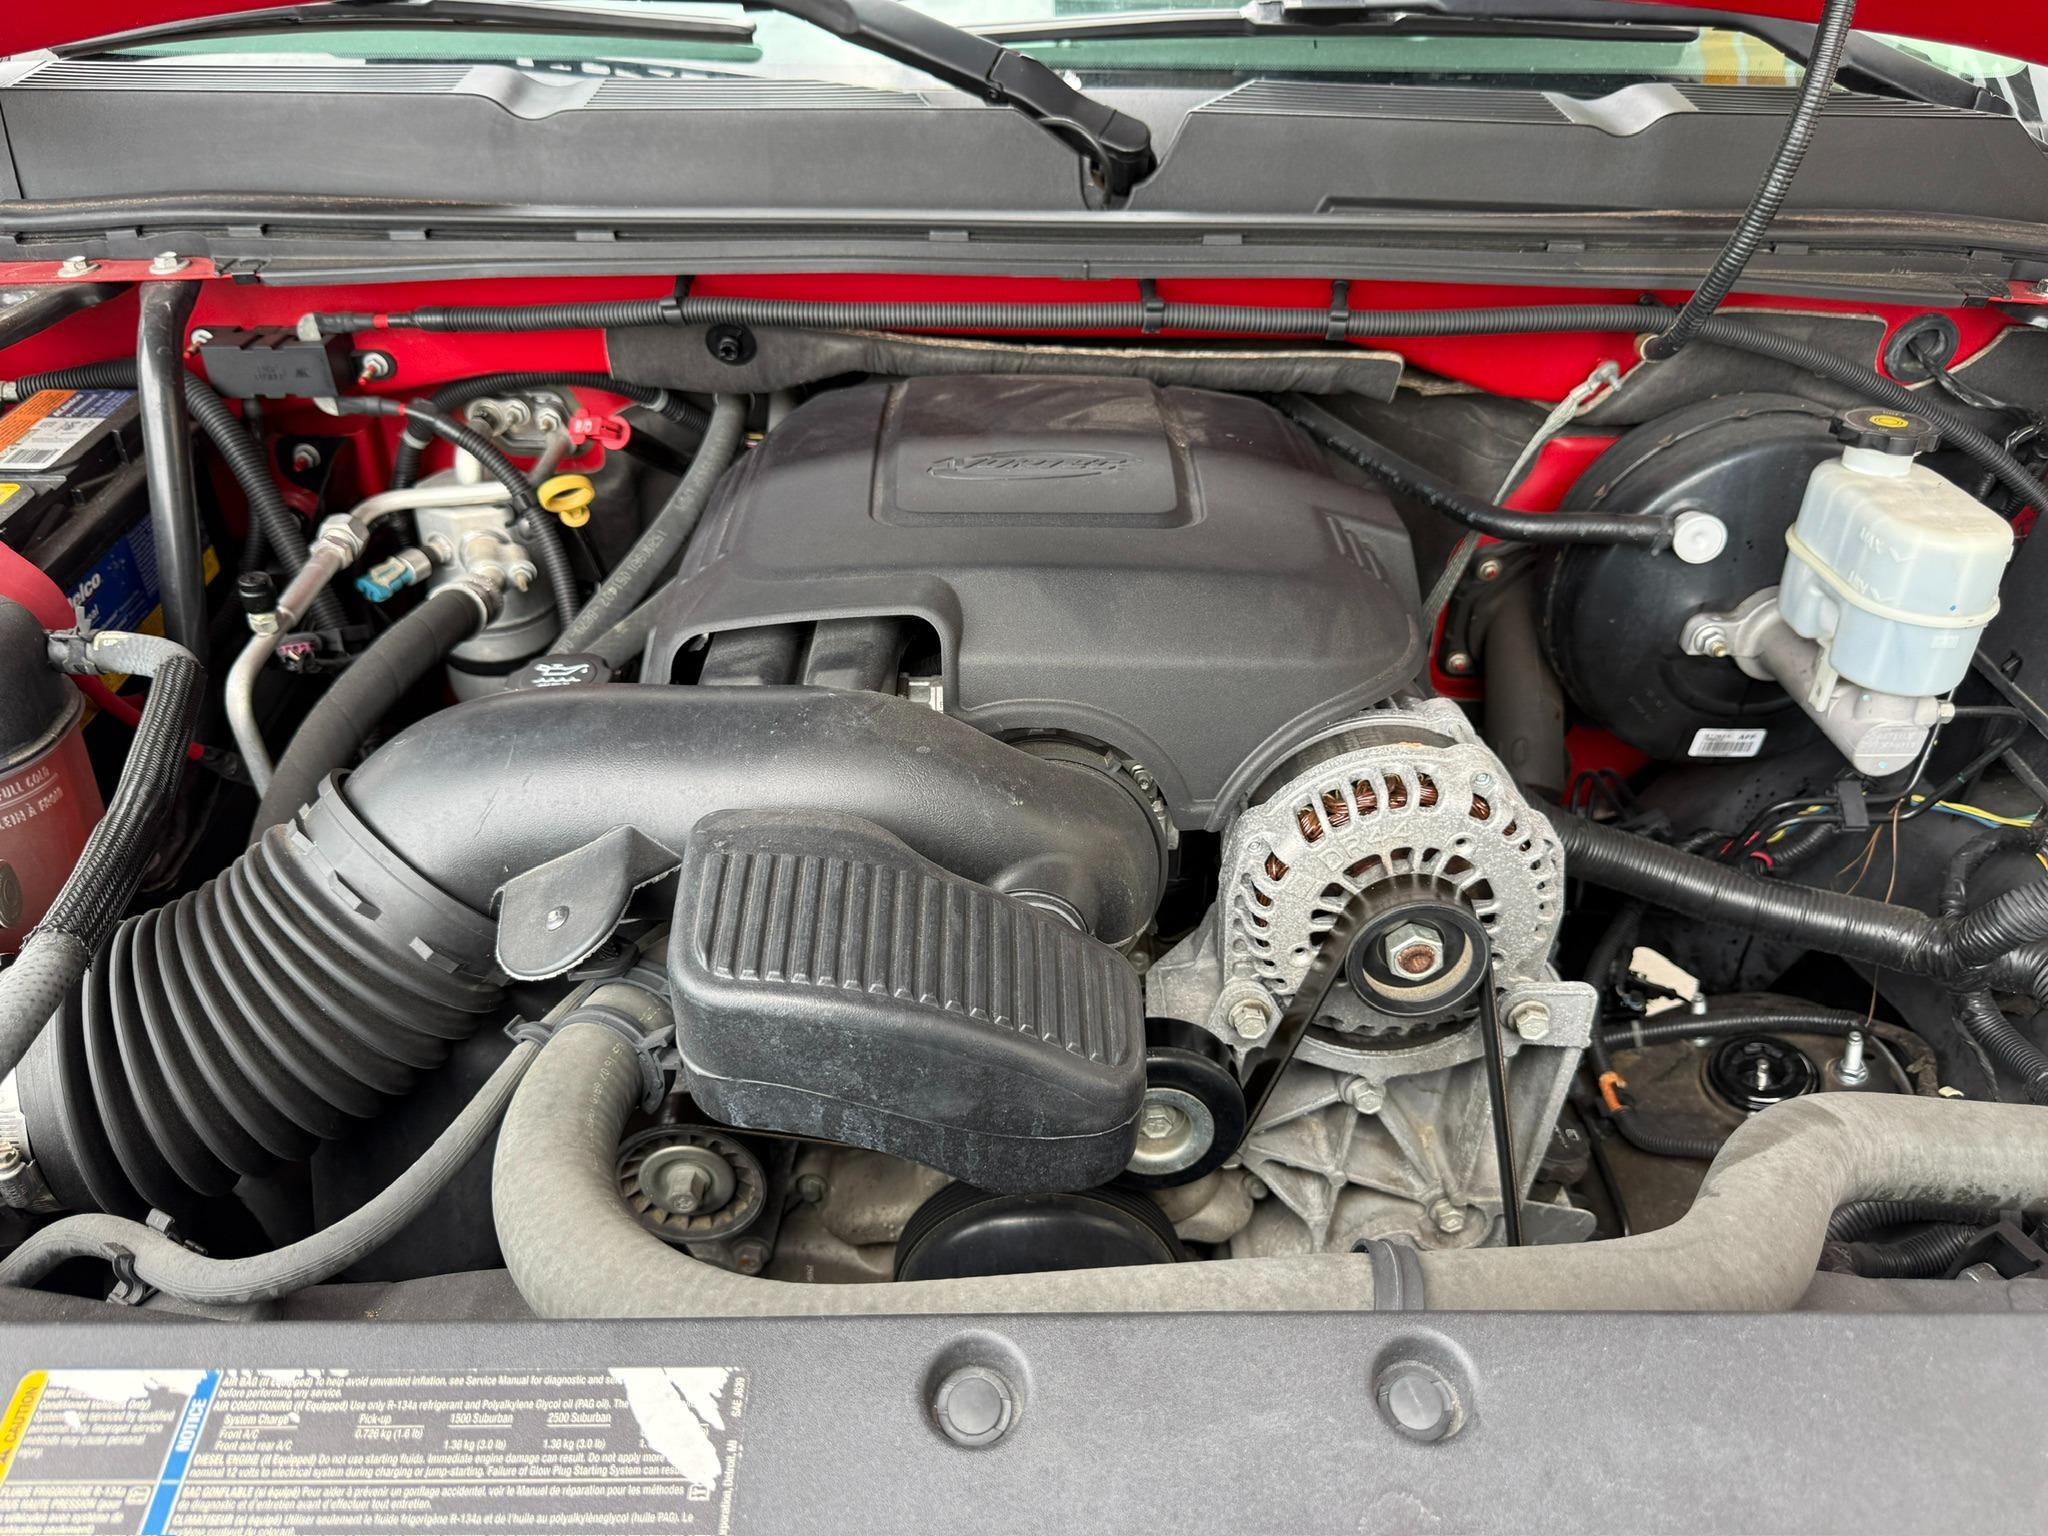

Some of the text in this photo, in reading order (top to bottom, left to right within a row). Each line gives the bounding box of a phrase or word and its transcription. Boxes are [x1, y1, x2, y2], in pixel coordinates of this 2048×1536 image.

[0, 766, 50, 801] ULL COLD
[0, 810, 27, 829] LEIN
[326, 1376, 344, 1387] help
[345, 1376, 369, 1386] avoid
[370, 1376, 412, 1386] unwanted
[448, 1376, 464, 1385] see
[465, 1376, 497, 1385] Service
[498, 1375, 530, 1385] Manual
[530, 1375, 542, 1385] for
[544, 1375, 586, 1386] diagnostic
[588, 1375, 604, 1385] and
[218, 1388, 245, 1398] before
[246, 1388, 292, 1399] performing
[294, 1388, 309, 1399] any
[731, 1376, 745, 1418] SAE J639
[213, 1401, 230, 1411] AIR
[230, 1401, 292, 1411] CONDITIONING
[350, 1400, 366, 1410] Use
[367, 1400, 386, 1411] only
[387, 1400, 418, 1409] R-134a
[418, 1400, 464, 1410] refrigerant
[464, 1399, 481, 1409] and
[482, 1399, 534, 1410] Polyalkylene
[535, 1399, 562, 1409] Glycol
[562, 1399, 574, 1408] oil
[574, 1399, 594, 1409] (PAG
[613, 1399, 629, 1408] The
[5, 1386, 38, 1443] CAUTION
[224, 1414, 289, 1425] System Charge
[450, 1413, 514, 1423] 1500 Suburban
[547, 1412, 612, 1422] 2500 Suburban
[176, 1398, 207, 1451] NOTICE
[219, 1429, 242, 1439] Front
[214, 1440, 238, 1450] Front
[238, 1440, 256, 1450] and
[256, 1440, 276, 1450] rear
[332, 1454, 346, 1464] not
[347, 1454, 364, 1464] use
[364, 1454, 398, 1465] starting
[426, 1454, 473, 1464] Immediate
[474, 1454, 504, 1465] engine
[504, 1454, 540, 1464] damage
[541, 1453, 558, 1463] can
[602, 1453, 616, 1462] not
[617, 1453, 641, 1463] apply
[642, 1453, 666, 1462] more
[190, 1467, 225, 1477] nominal
[238, 1467, 260, 1477] volts
[272, 1467, 312, 1477] electrical
[312, 1466, 344, 1478] system
[345, 1466, 374, 1477] during
[375, 1466, 412, 1477] charging
[487, 1466, 517, 1475] Failure
[530, 1466, 552, 1475] Glow
[552, 1465, 572, 1476] Plug
[573, 1465, 608, 1476] Starting
[609, 1465, 642, 1476] System
[642, 1465, 660, 1474] can
[403, 1486, 440, 1498] gonflage
[488, 1486, 505, 1496] voir
[516, 1486, 548, 1496] Manuel
[562, 1485, 605, 1497] réparation
[606, 1485, 626, 1497] pour
[628, 1485, 641, 1495] les
[642, 1485, 685, 1495] méthodes
